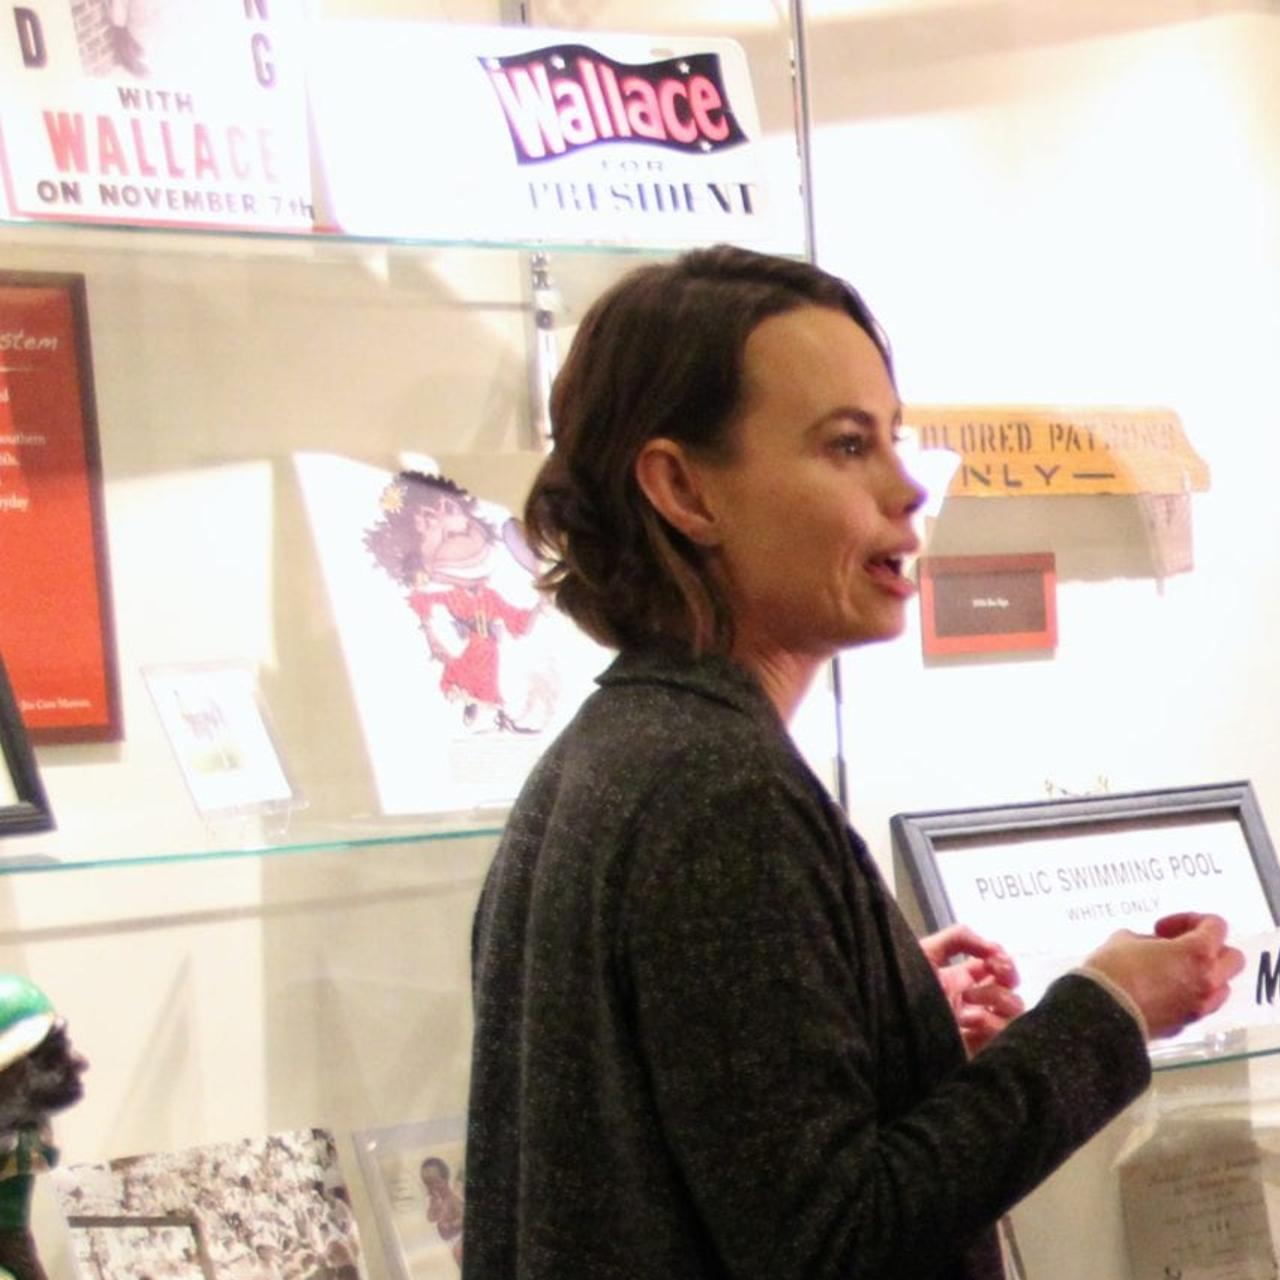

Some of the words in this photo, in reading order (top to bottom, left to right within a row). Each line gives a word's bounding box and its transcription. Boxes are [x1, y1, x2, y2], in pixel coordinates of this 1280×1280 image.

[117, 86, 194, 113] WITH
[488, 56, 731, 159] Wallace
[42, 110, 281, 185] WALLACE
[36, 180, 81, 205] ON
[98, 183, 257, 215] NOVEMBER
[528, 181, 757, 215] PRESIDENT
[962, 464, 1061, 488] NLY
[975, 868, 1053, 902] PUBLIC
[1056, 856, 1165, 893] SWIMMING
[1168, 852, 1223, 878] POOL
[1066, 902, 1113, 921] WHITE
[1121, 897, 1160, 915] ONLY
